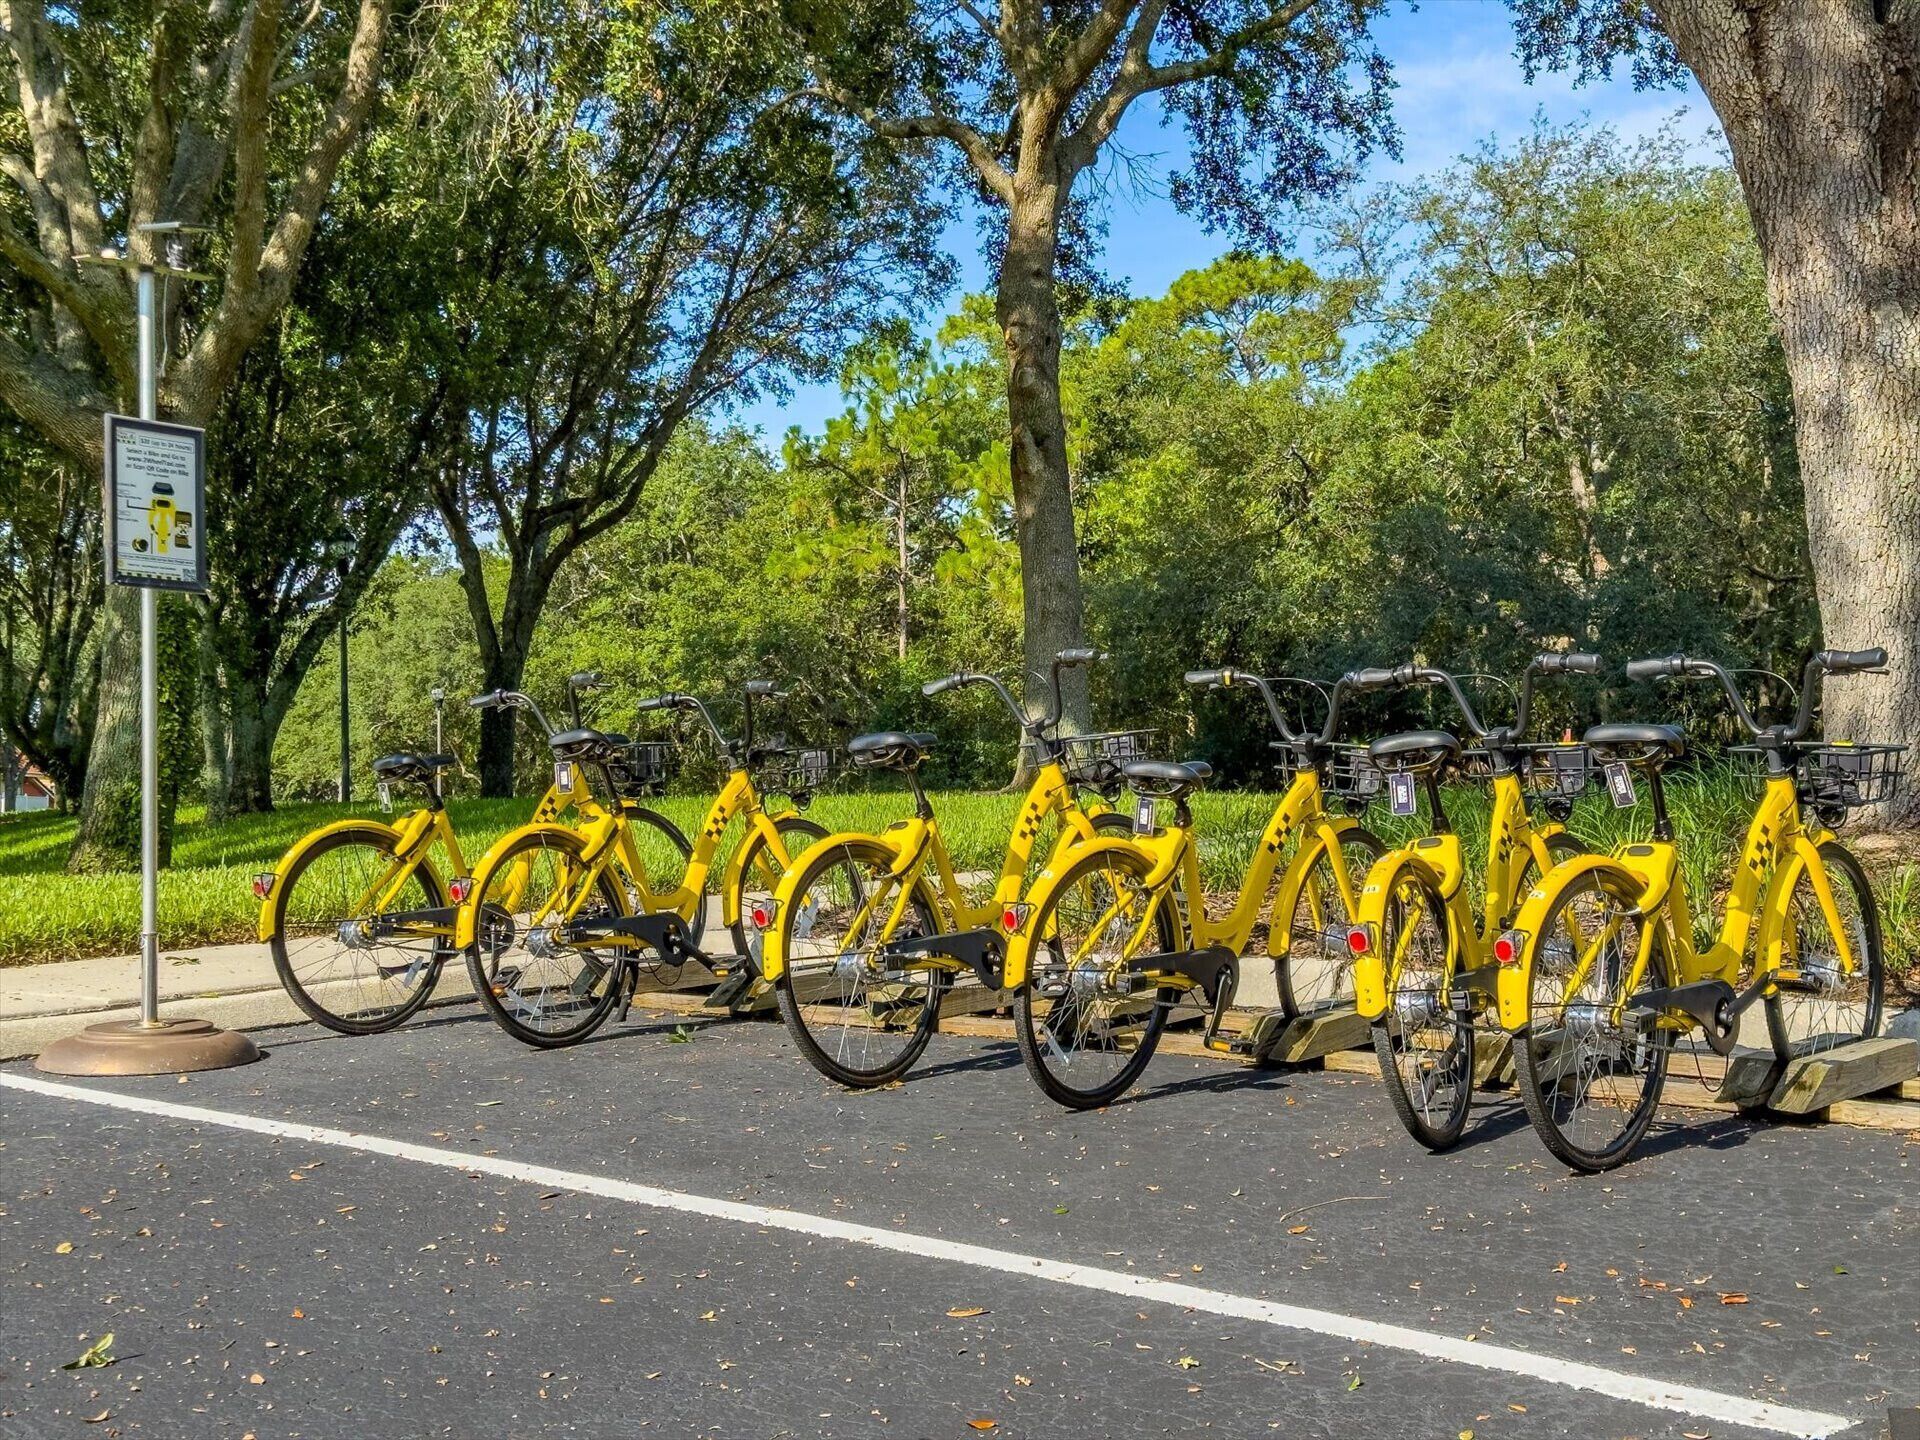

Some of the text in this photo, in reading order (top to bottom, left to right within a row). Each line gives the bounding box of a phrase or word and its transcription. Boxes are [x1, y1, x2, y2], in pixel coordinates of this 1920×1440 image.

[126, 447, 142, 455] Select
[156, 466, 169, 474] Code
[178, 469, 189, 477] Bike
